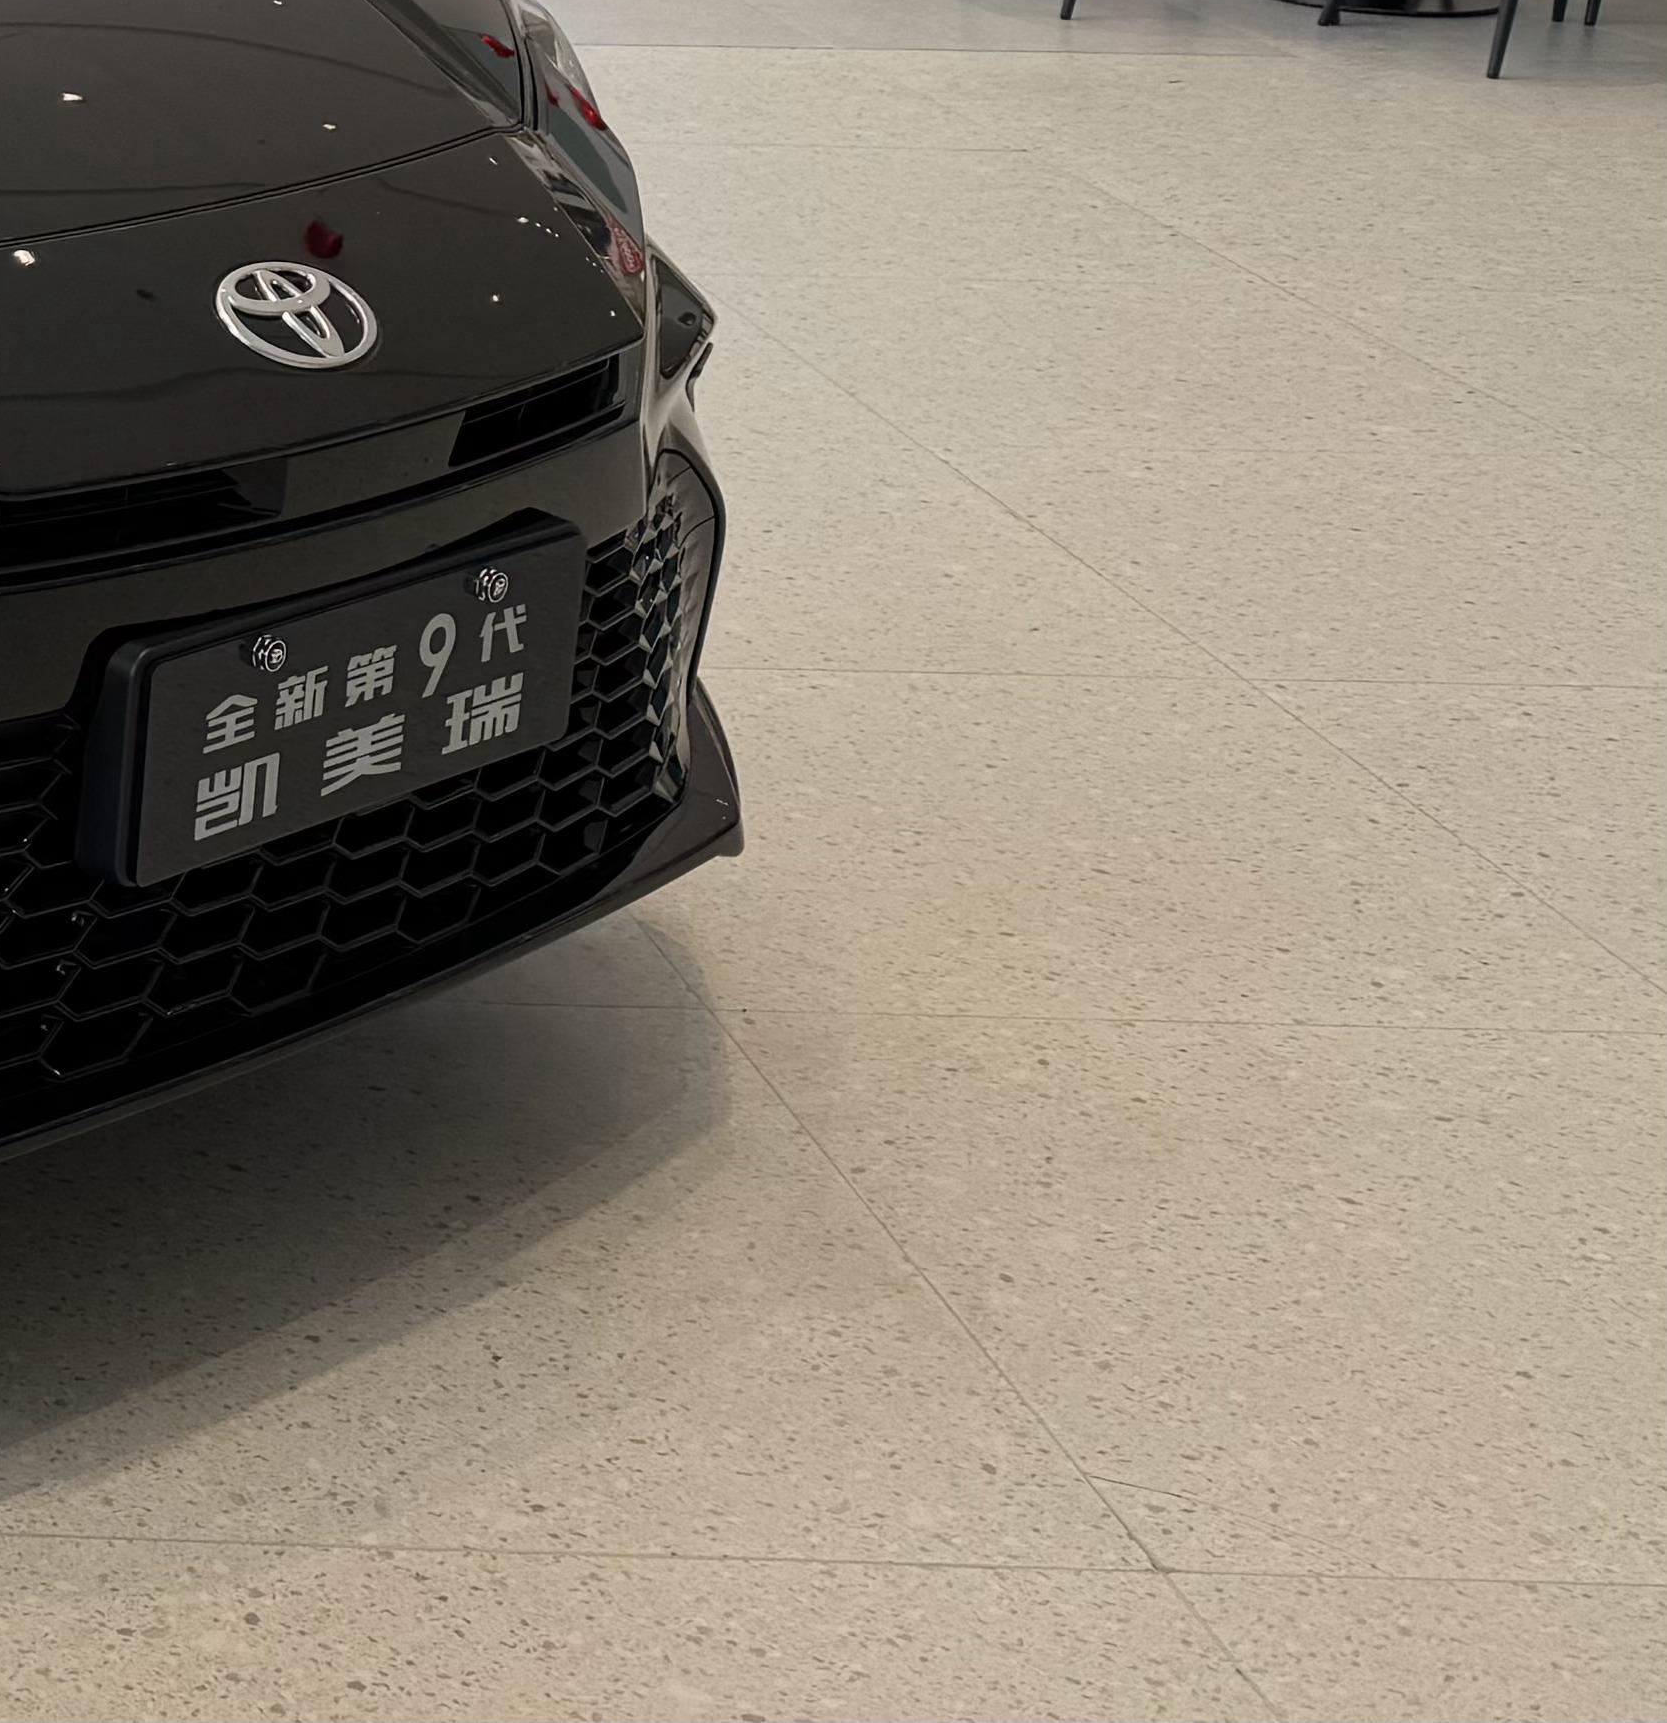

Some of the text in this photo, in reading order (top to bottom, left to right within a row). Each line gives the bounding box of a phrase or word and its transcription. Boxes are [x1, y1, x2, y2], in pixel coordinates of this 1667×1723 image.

[194, 673, 523, 841] 凯美瑞
[203, 604, 527, 754] 全新第9代
